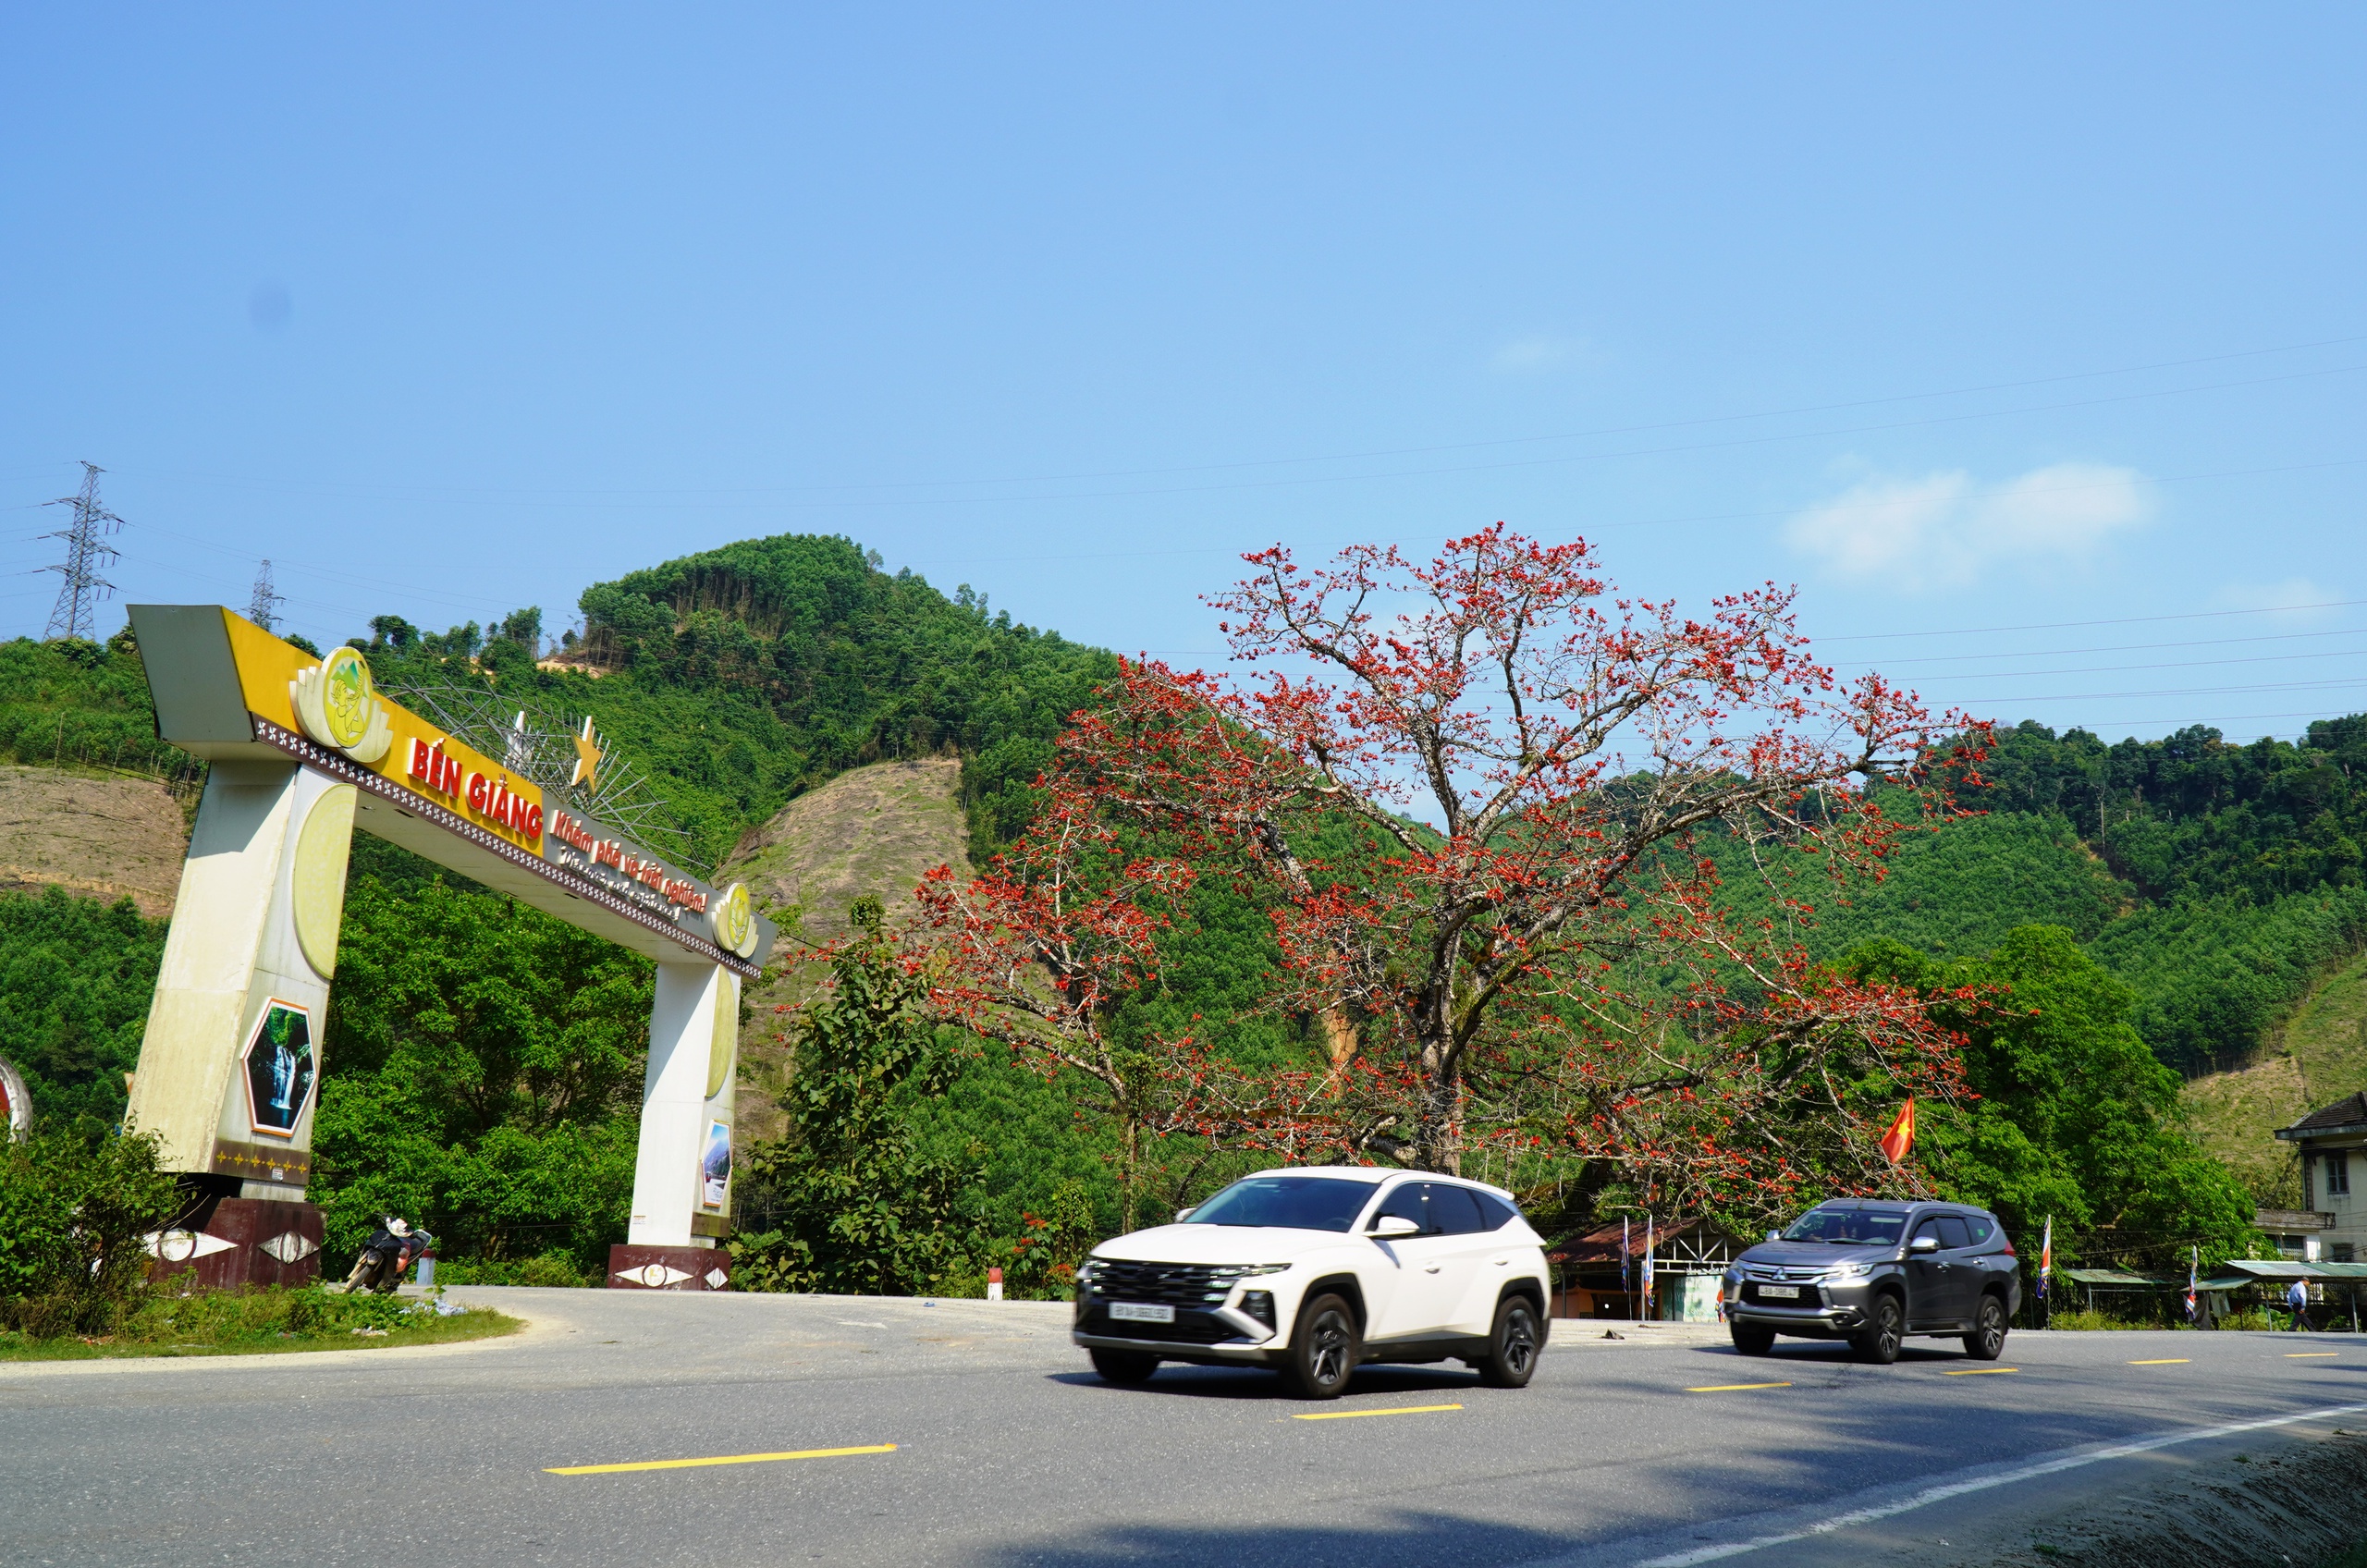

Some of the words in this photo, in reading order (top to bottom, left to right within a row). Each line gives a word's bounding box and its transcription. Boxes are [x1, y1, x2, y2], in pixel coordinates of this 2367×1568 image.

[407, 737, 463, 800] BẾN
[549, 809, 595, 853] Khám
[590, 839, 622, 869] phá
